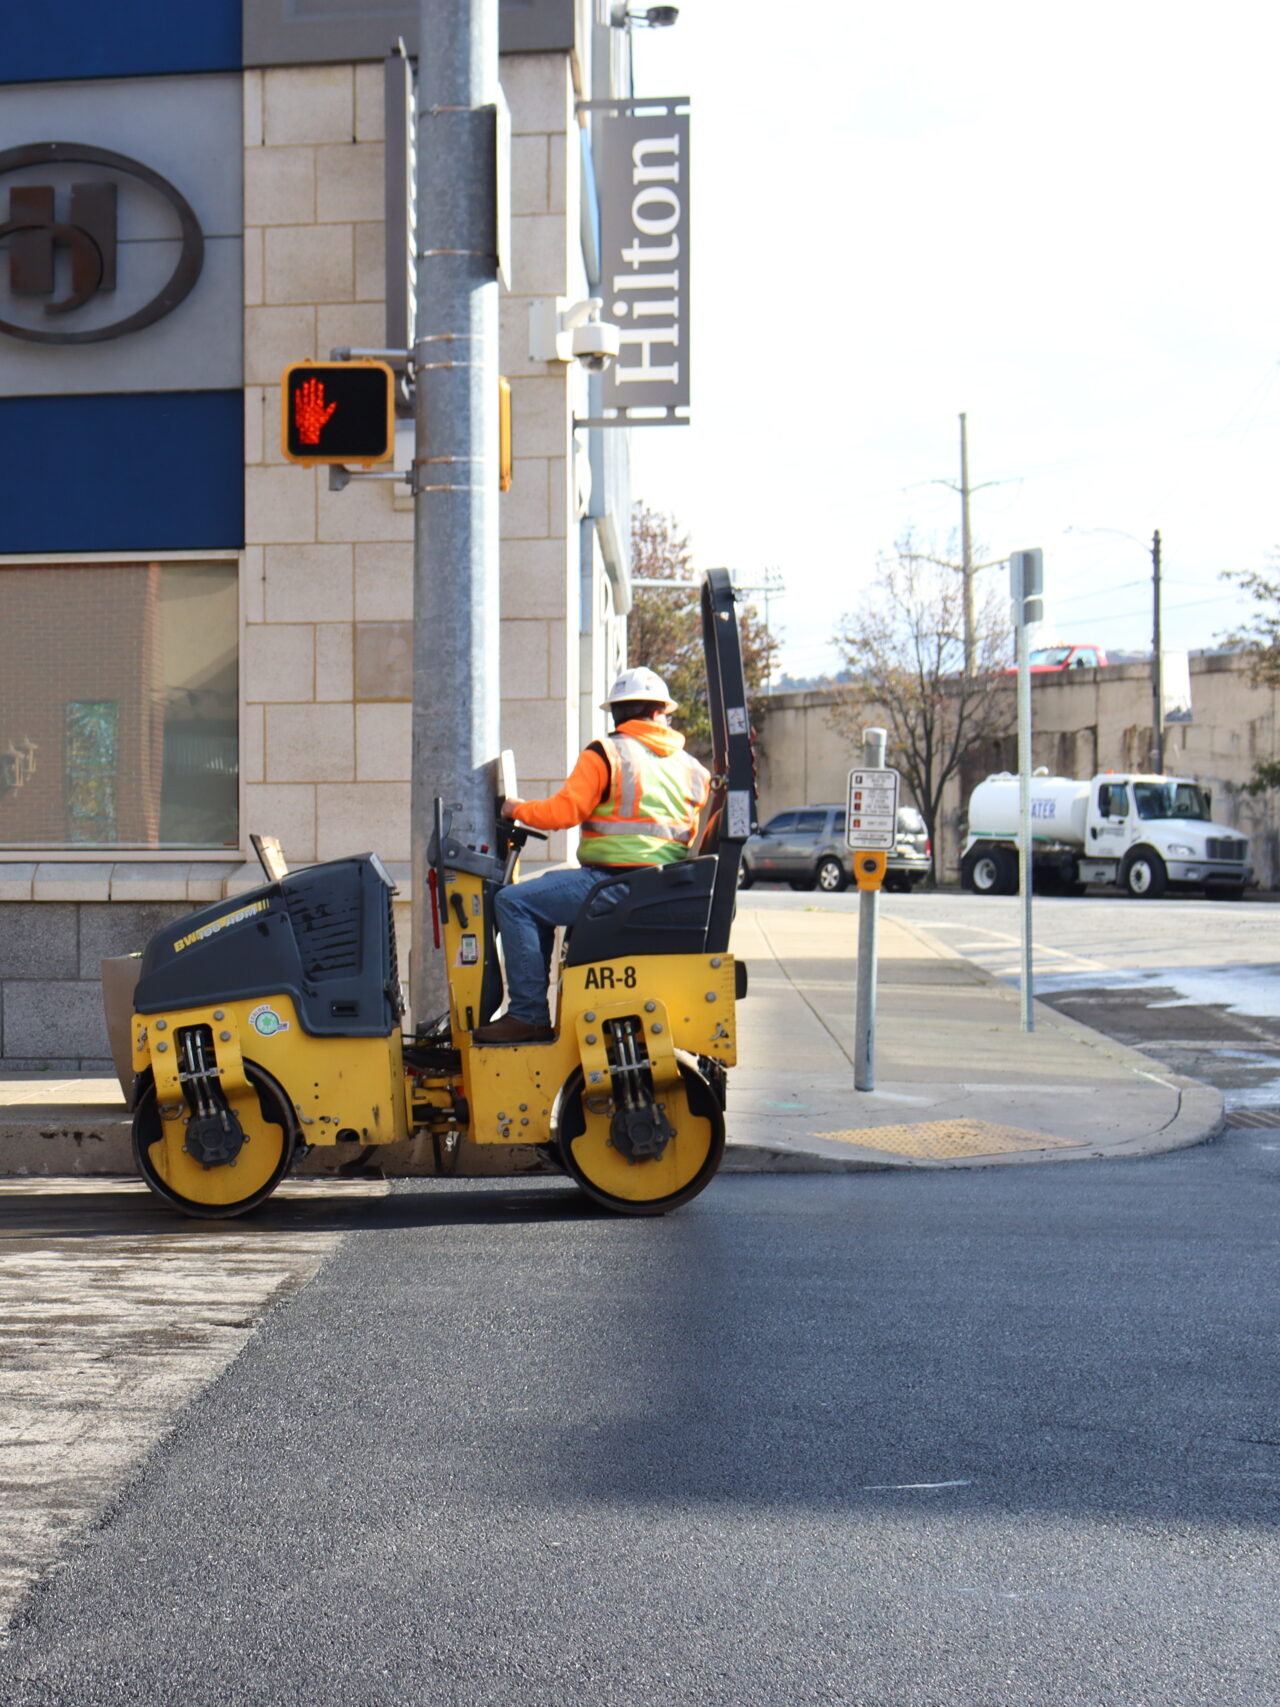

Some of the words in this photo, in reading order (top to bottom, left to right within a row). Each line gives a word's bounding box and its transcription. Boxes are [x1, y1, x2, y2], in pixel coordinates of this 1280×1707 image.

[612, 132, 681, 387] Hilton
[1031, 802, 1056, 819] ATER
[584, 966, 637, 989] AR-8
